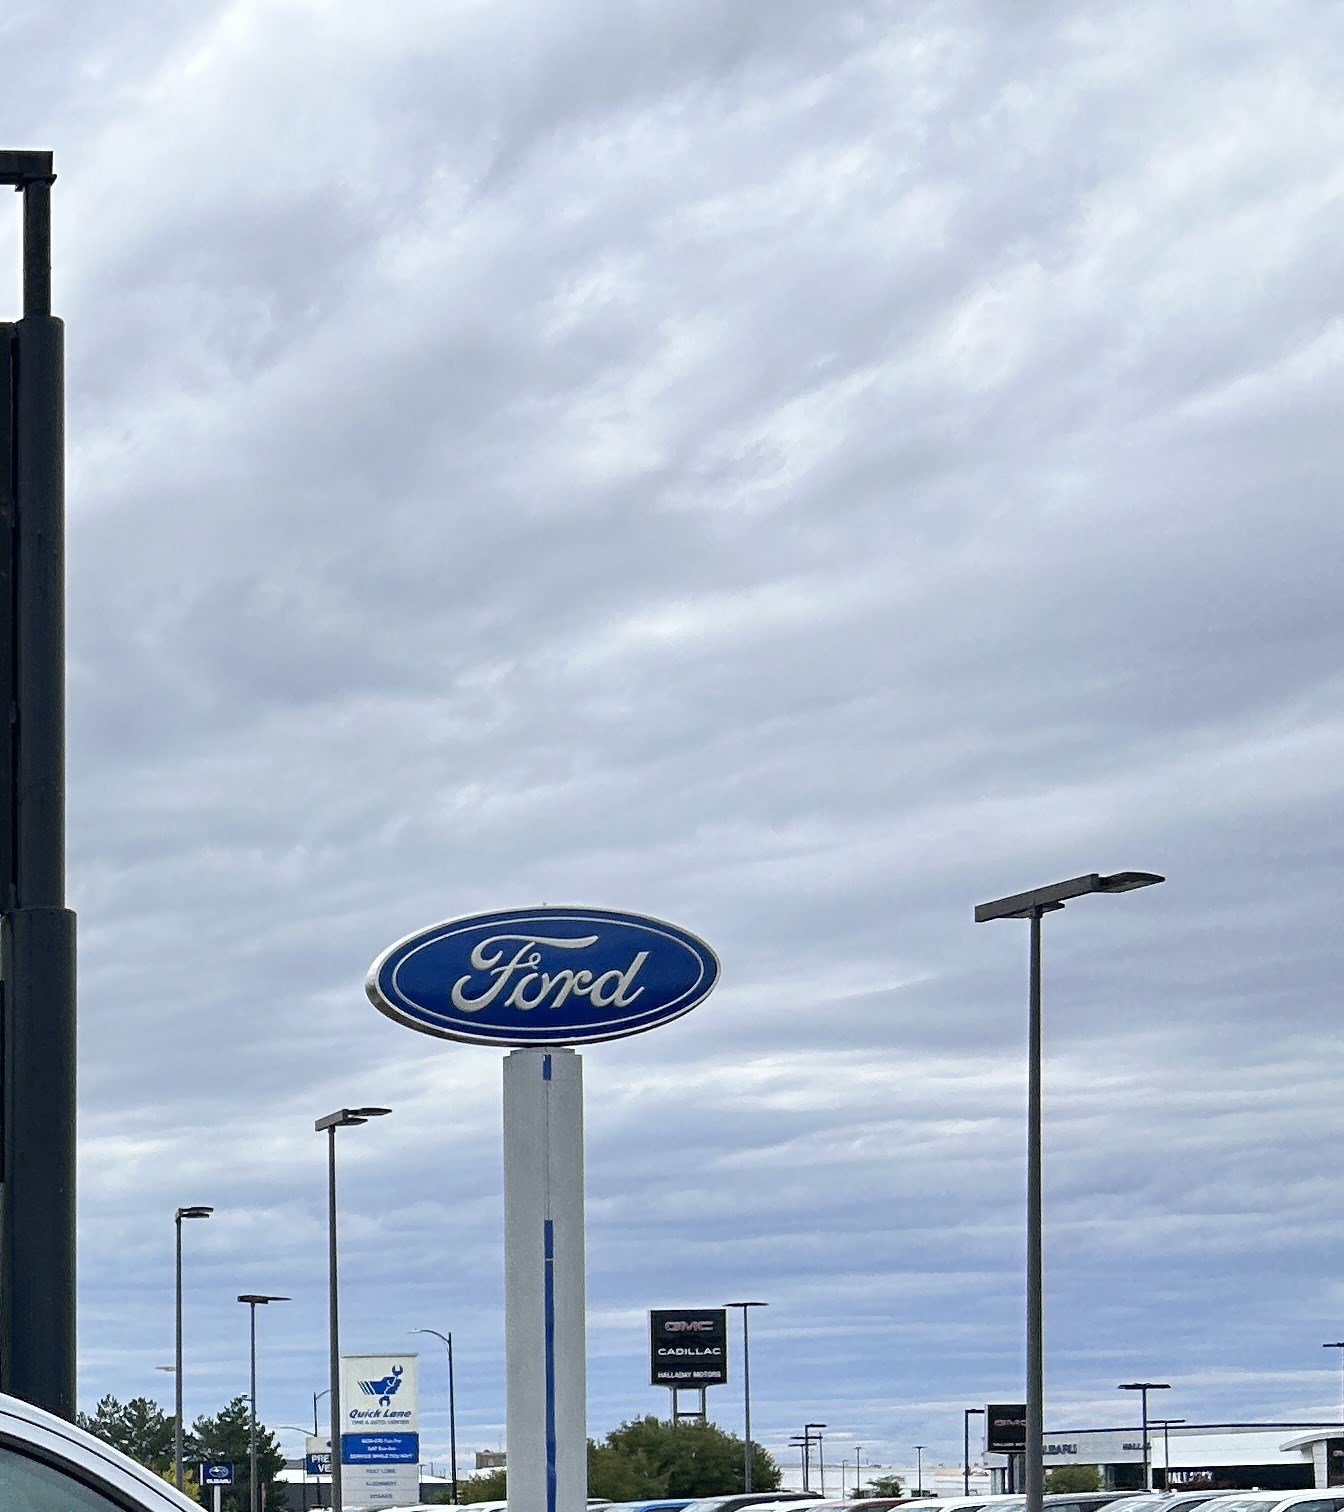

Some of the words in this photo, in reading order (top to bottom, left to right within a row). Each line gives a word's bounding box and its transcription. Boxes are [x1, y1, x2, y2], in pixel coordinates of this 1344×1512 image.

[451, 934, 649, 1013] Ford
[664, 1320, 714, 1332] GMC
[657, 1347, 722, 1356] CADILLAC
[349, 1408, 382, 1419] Quick
[383, 1408, 412, 1418] Lane
[1042, 1443, 1078, 1455] UBARU
[311, 1454, 331, 1464] PRE
